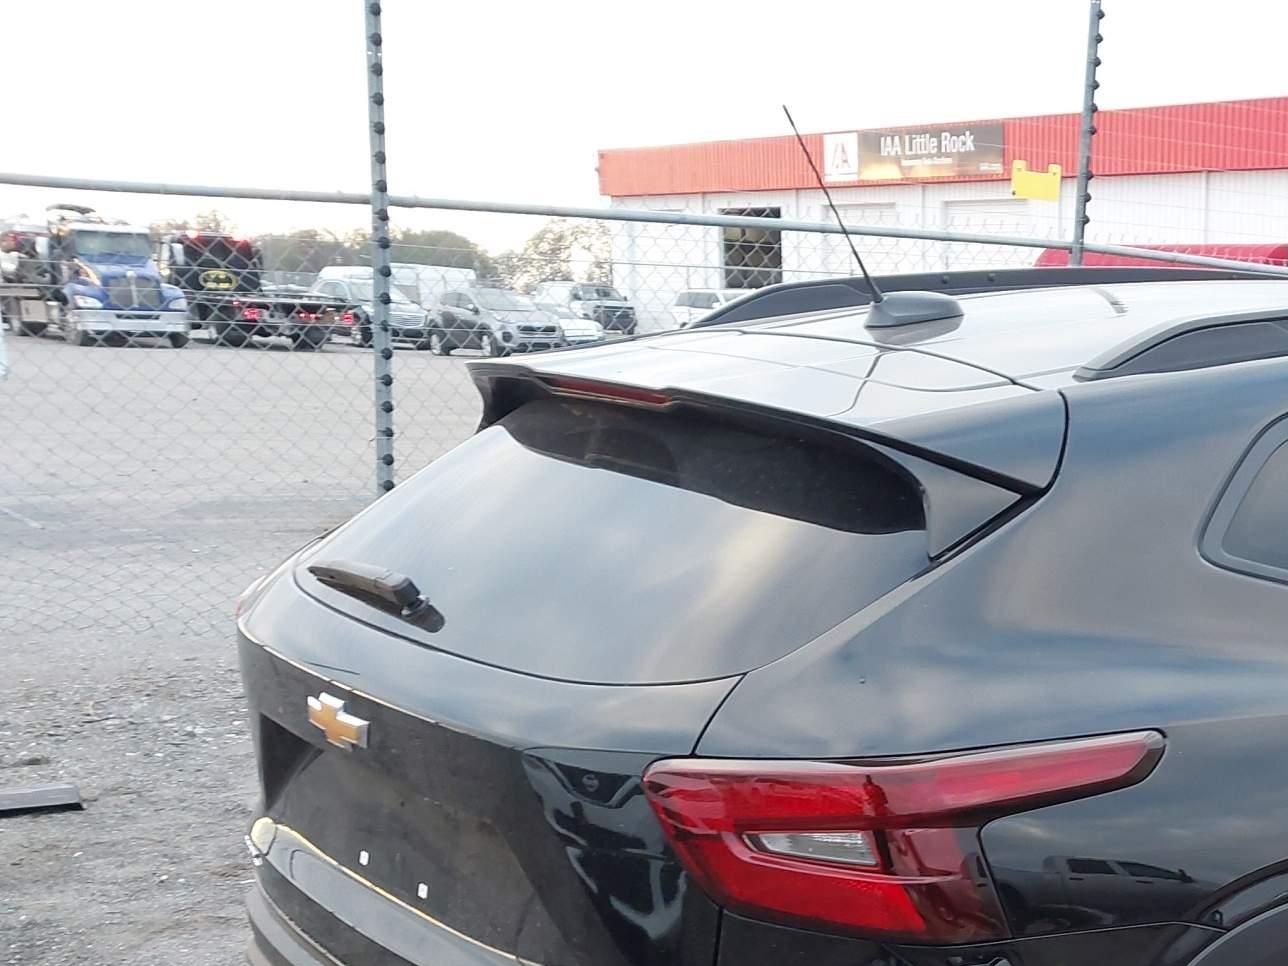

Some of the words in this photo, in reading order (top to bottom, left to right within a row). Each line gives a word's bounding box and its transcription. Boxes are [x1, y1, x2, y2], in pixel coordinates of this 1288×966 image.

[880, 135, 902, 156] IAA
[904, 133, 938, 155] Little
[941, 130, 976, 153] Rock
